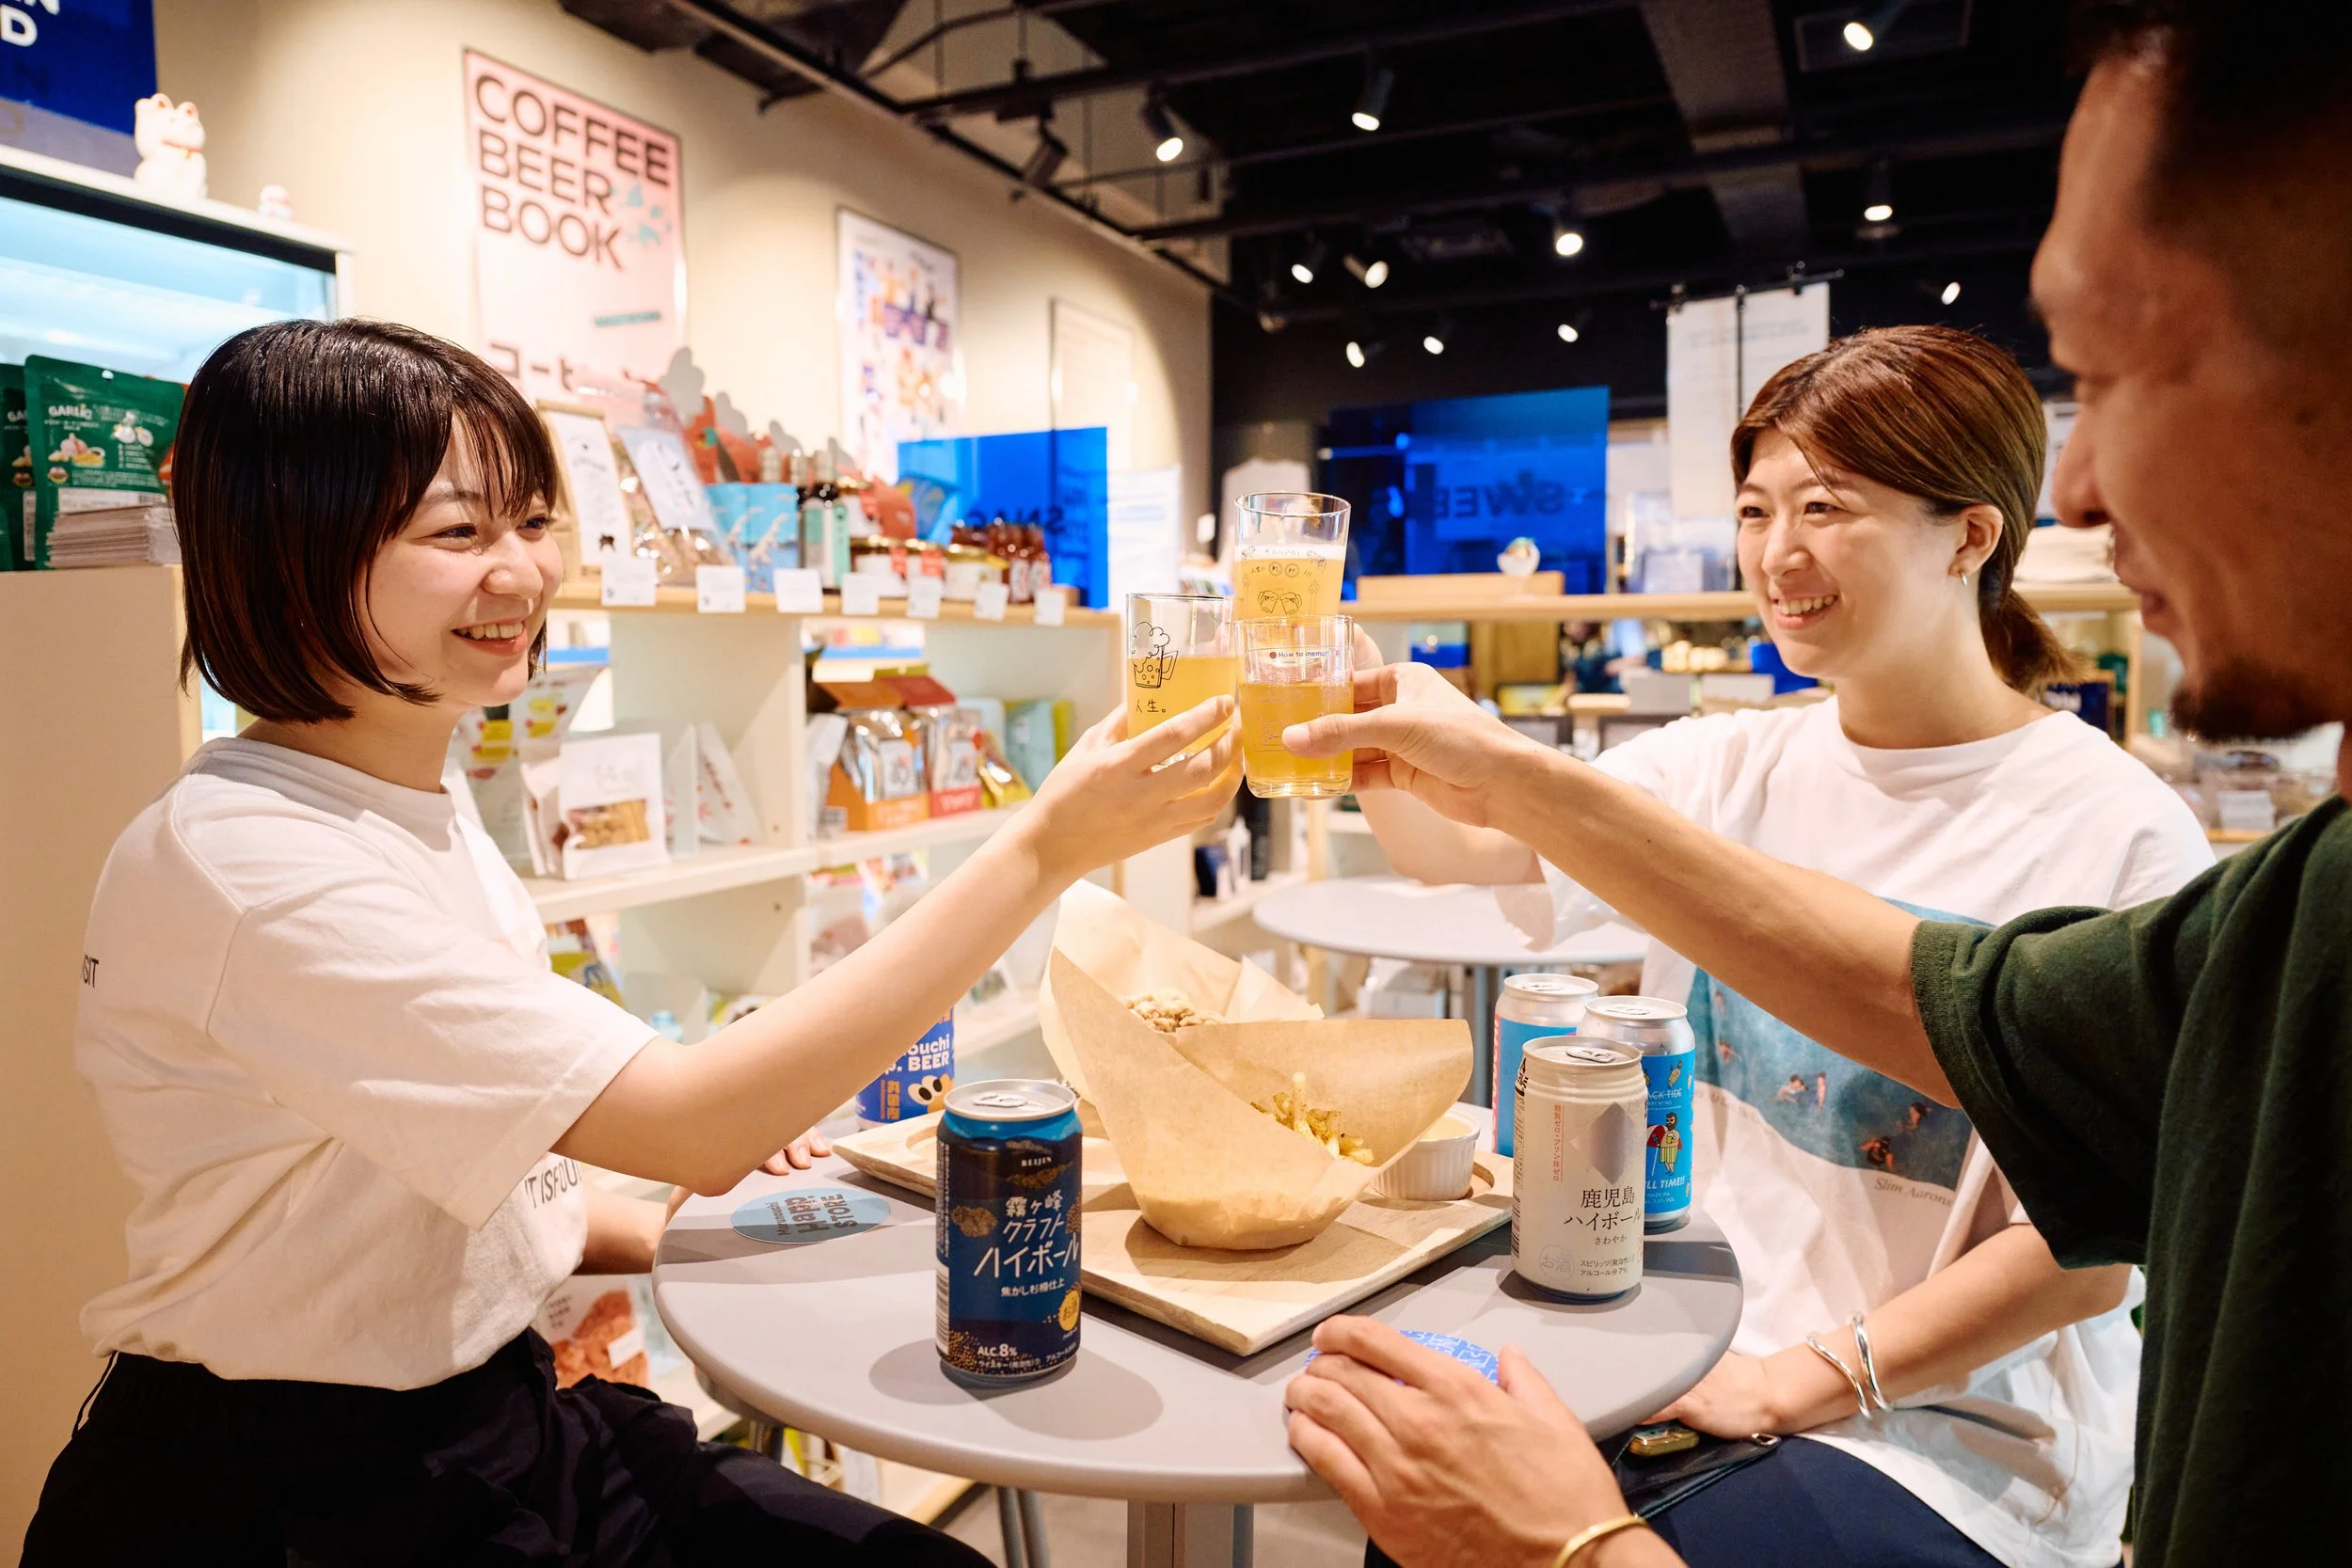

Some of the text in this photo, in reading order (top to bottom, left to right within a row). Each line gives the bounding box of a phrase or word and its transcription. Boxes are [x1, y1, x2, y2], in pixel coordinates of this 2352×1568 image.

[476, 75, 670, 187] COFFEE
[480, 129, 611, 215] BEER
[483, 185, 622, 271] BOOK
[81, 955, 99, 989] SIT
[905, 1033, 950, 1055] ouchi
[908, 1051, 949, 1072] BEER
[1581, 1185, 1635, 1209] 鹿児島
[1874, 1177, 1952, 1206] Slim Aarons
[820, 1194, 858, 1228] STORE
[1563, 1208, 1642, 1231] ハイボール
[1003, 1212, 1064, 1243] クラフト
[1595, 1234, 1627, 1245] さわやか
[973, 1232, 1079, 1278] ハイボール
